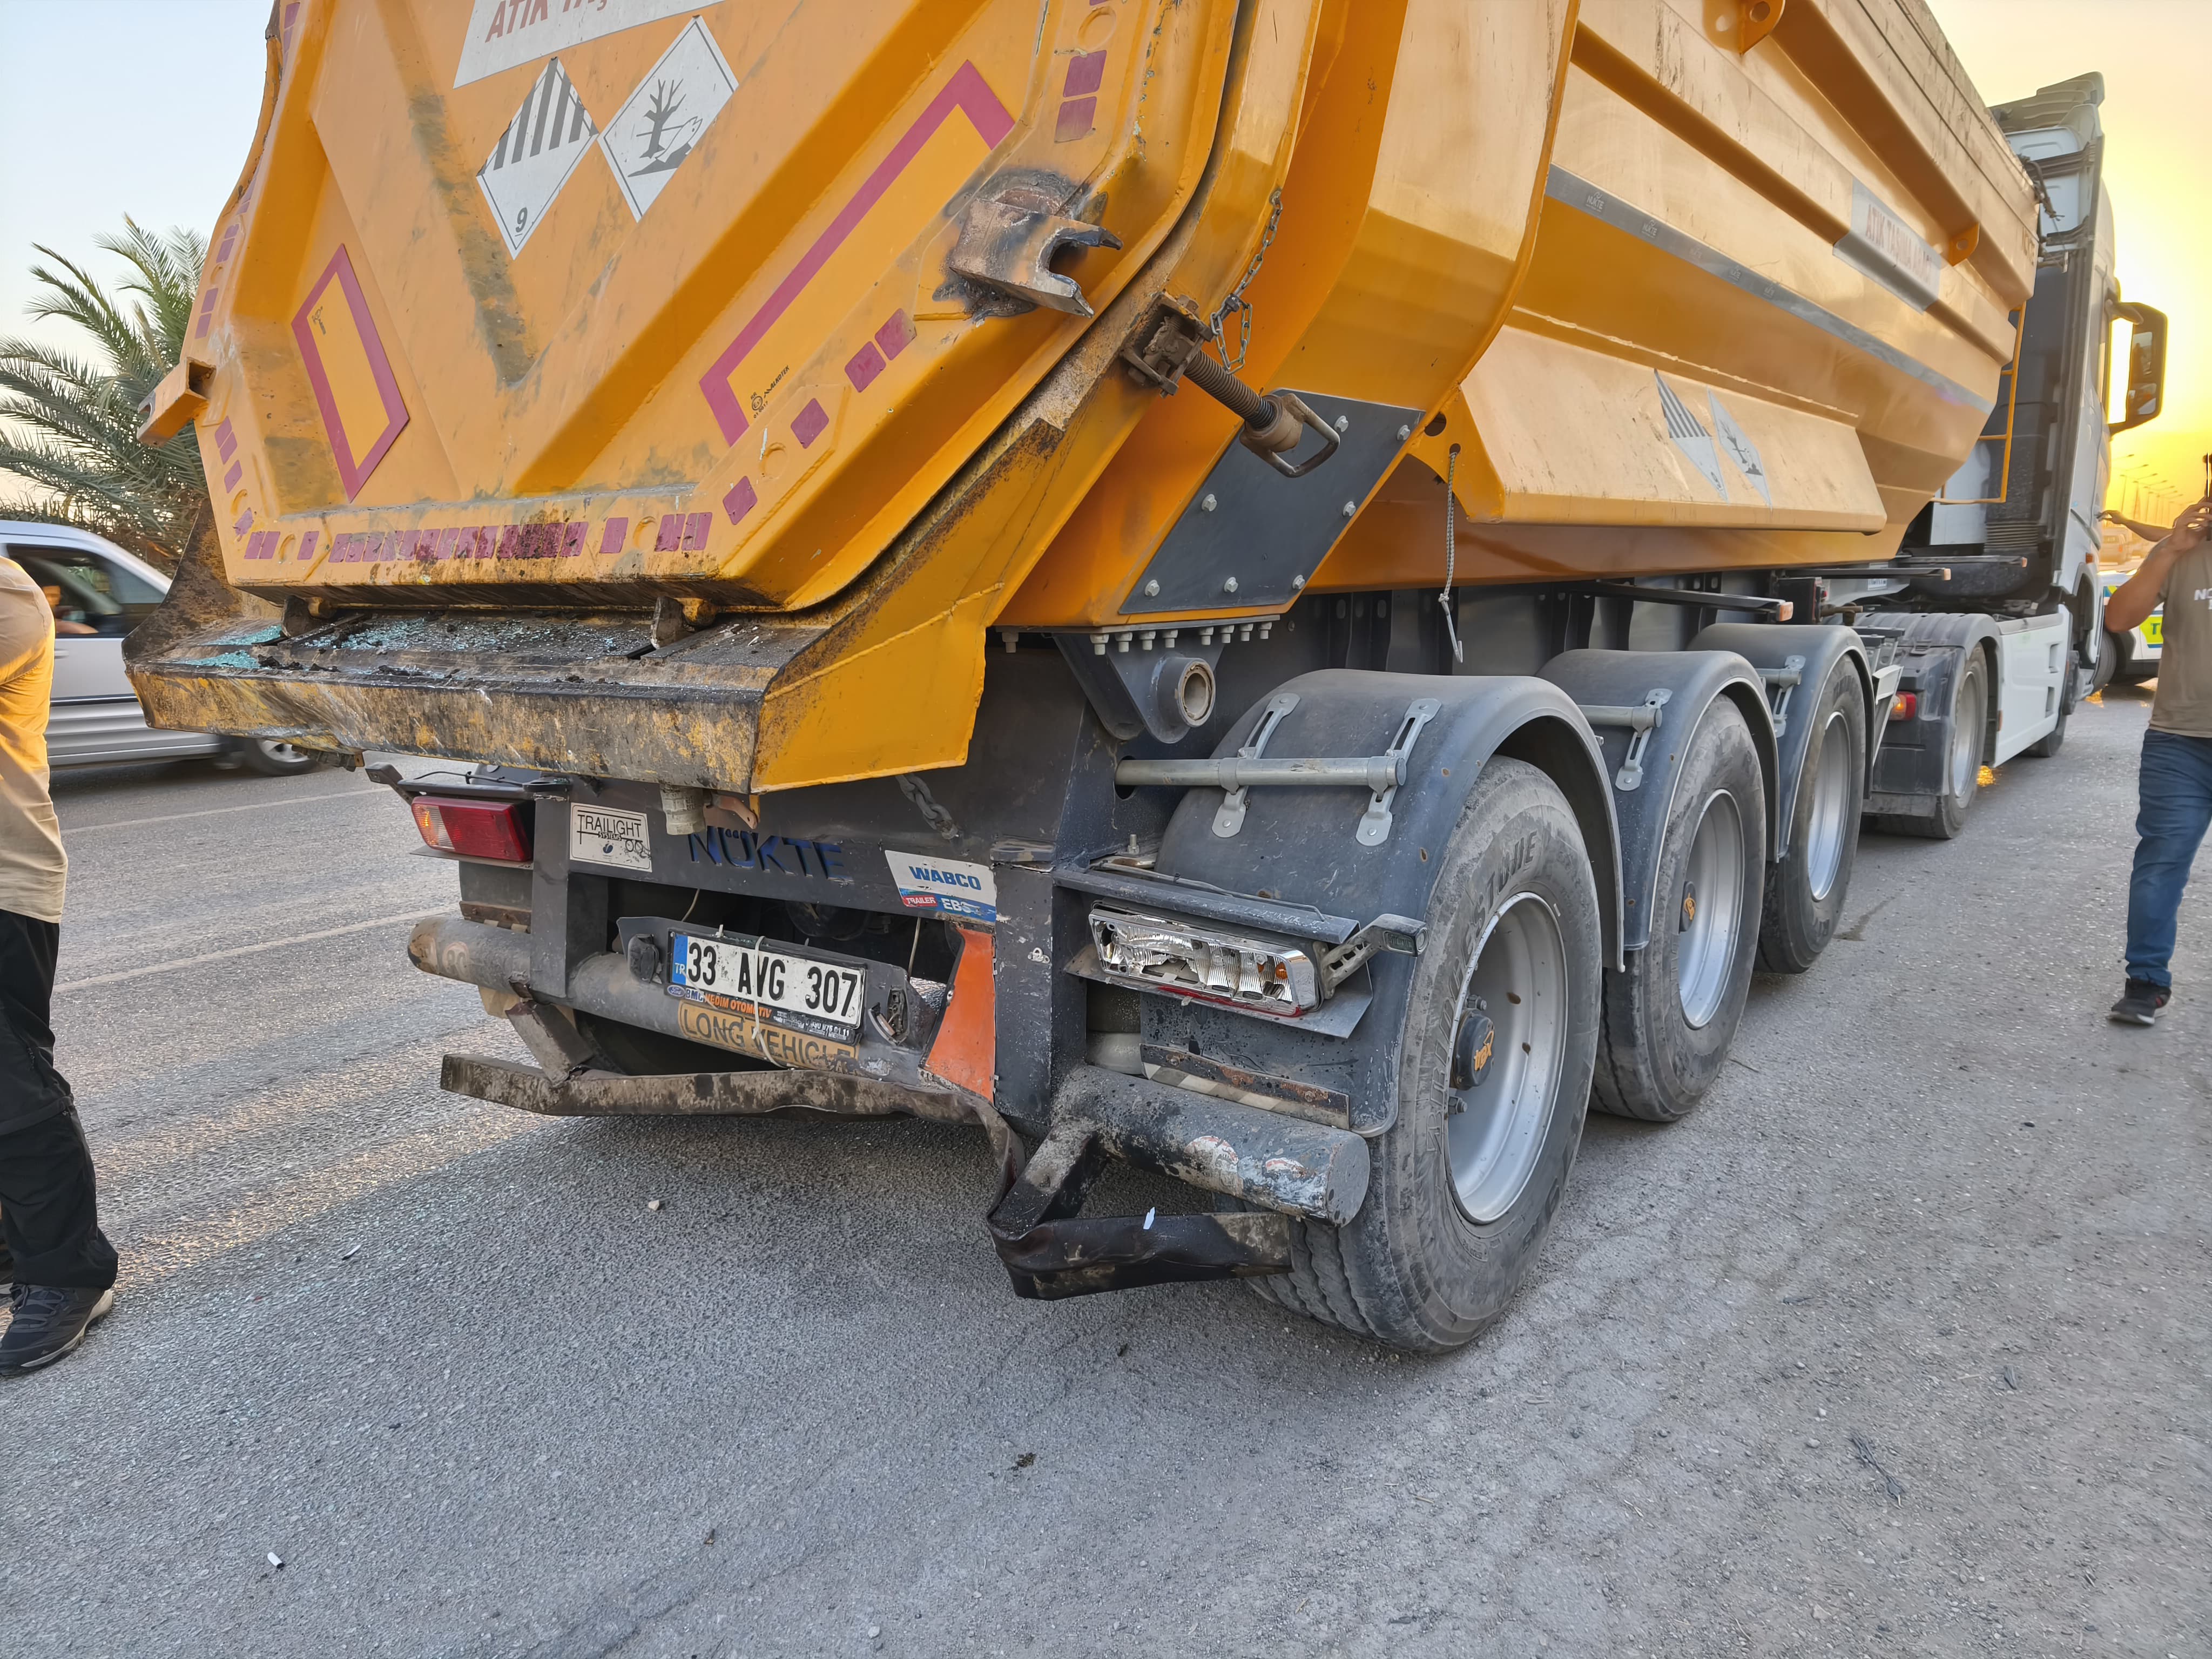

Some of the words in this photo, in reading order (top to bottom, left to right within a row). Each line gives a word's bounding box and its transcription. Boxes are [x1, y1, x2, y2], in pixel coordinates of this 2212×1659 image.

[485, 0, 548, 43] ATIK
[514, 207, 529, 233] 9
[577, 814, 642, 844] TRAILIGHT
[597, 831, 622, 841] SYSTEMS
[688, 825, 855, 884] NÜKTE
[908, 866, 982, 891] WABCO
[905, 896, 937, 905] TRAILER
[675, 962, 685, 975] TR
[687, 942, 717, 986] 33
[737, 952, 786, 1001] AVG
[805, 966, 858, 1016] 307
[683, 1008, 745, 1048] LONG
[751, 1025, 851, 1069] VEHICL
